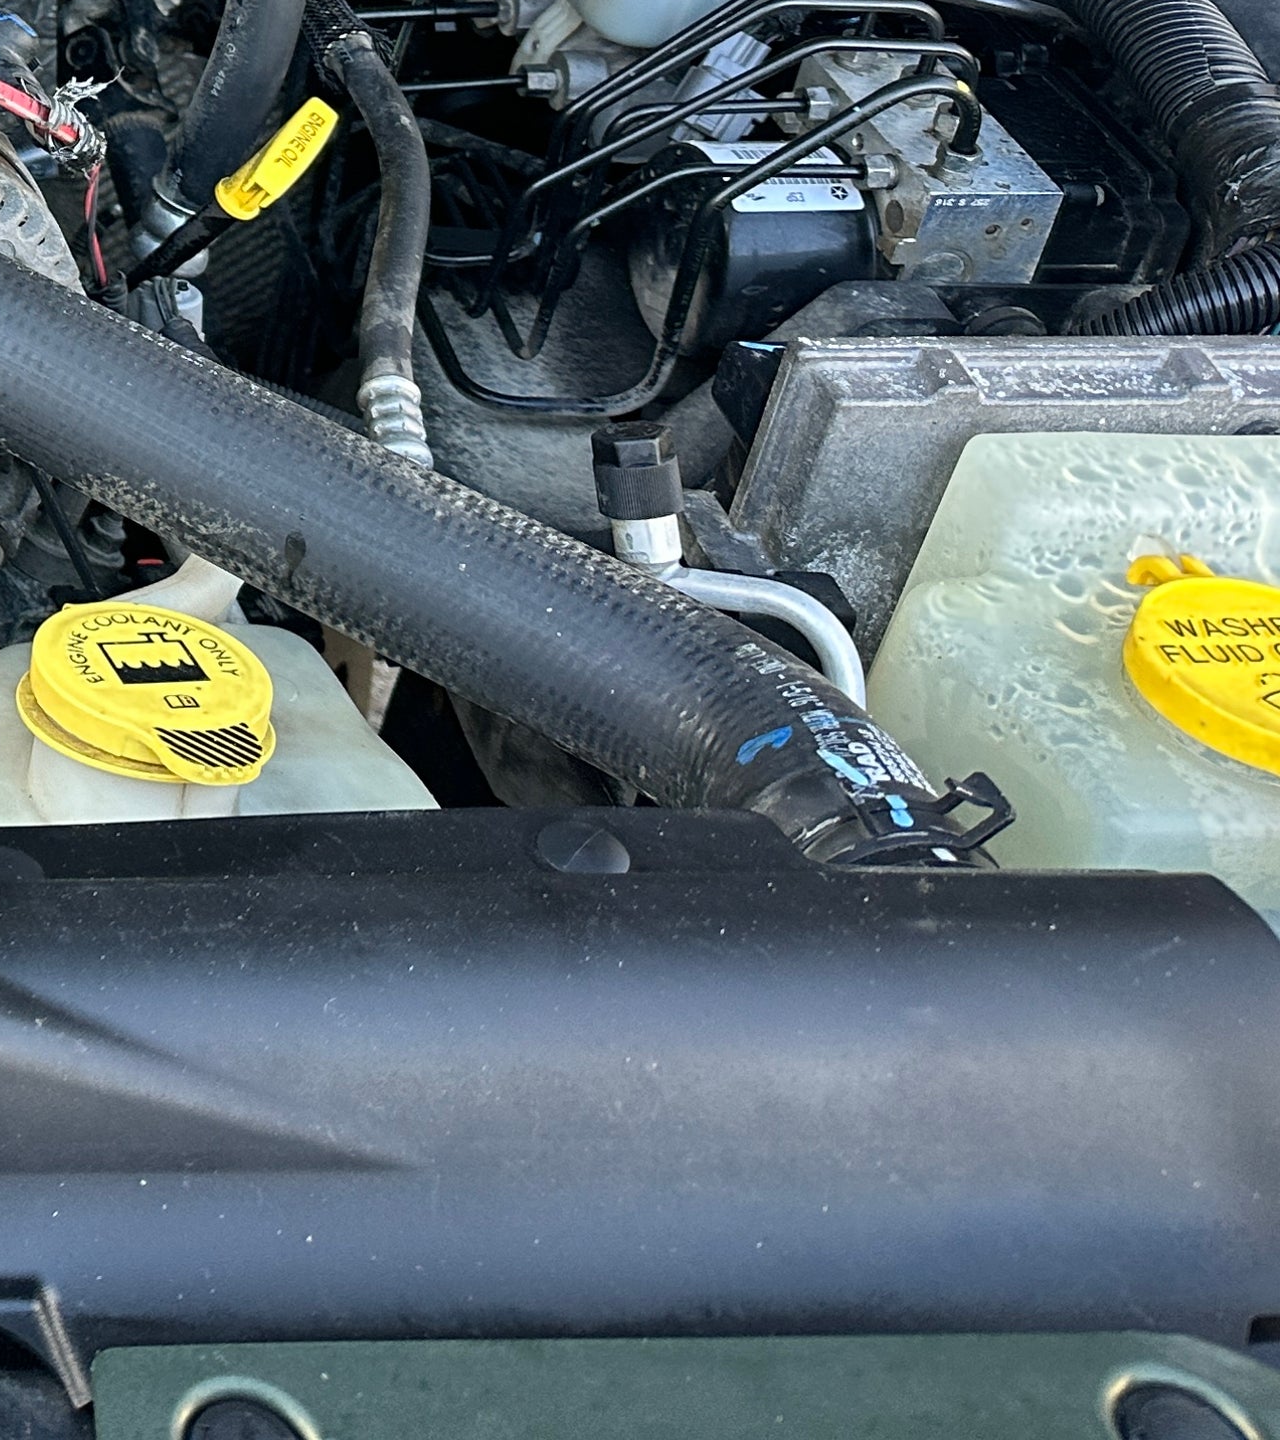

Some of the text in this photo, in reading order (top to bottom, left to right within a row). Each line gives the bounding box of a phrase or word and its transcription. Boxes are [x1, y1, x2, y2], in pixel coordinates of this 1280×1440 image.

[274, 112, 326, 178] ENGINE OIL
[67, 613, 241, 684] ENGINE COOLANT ONLY
[1158, 644, 1265, 663] FLUID
